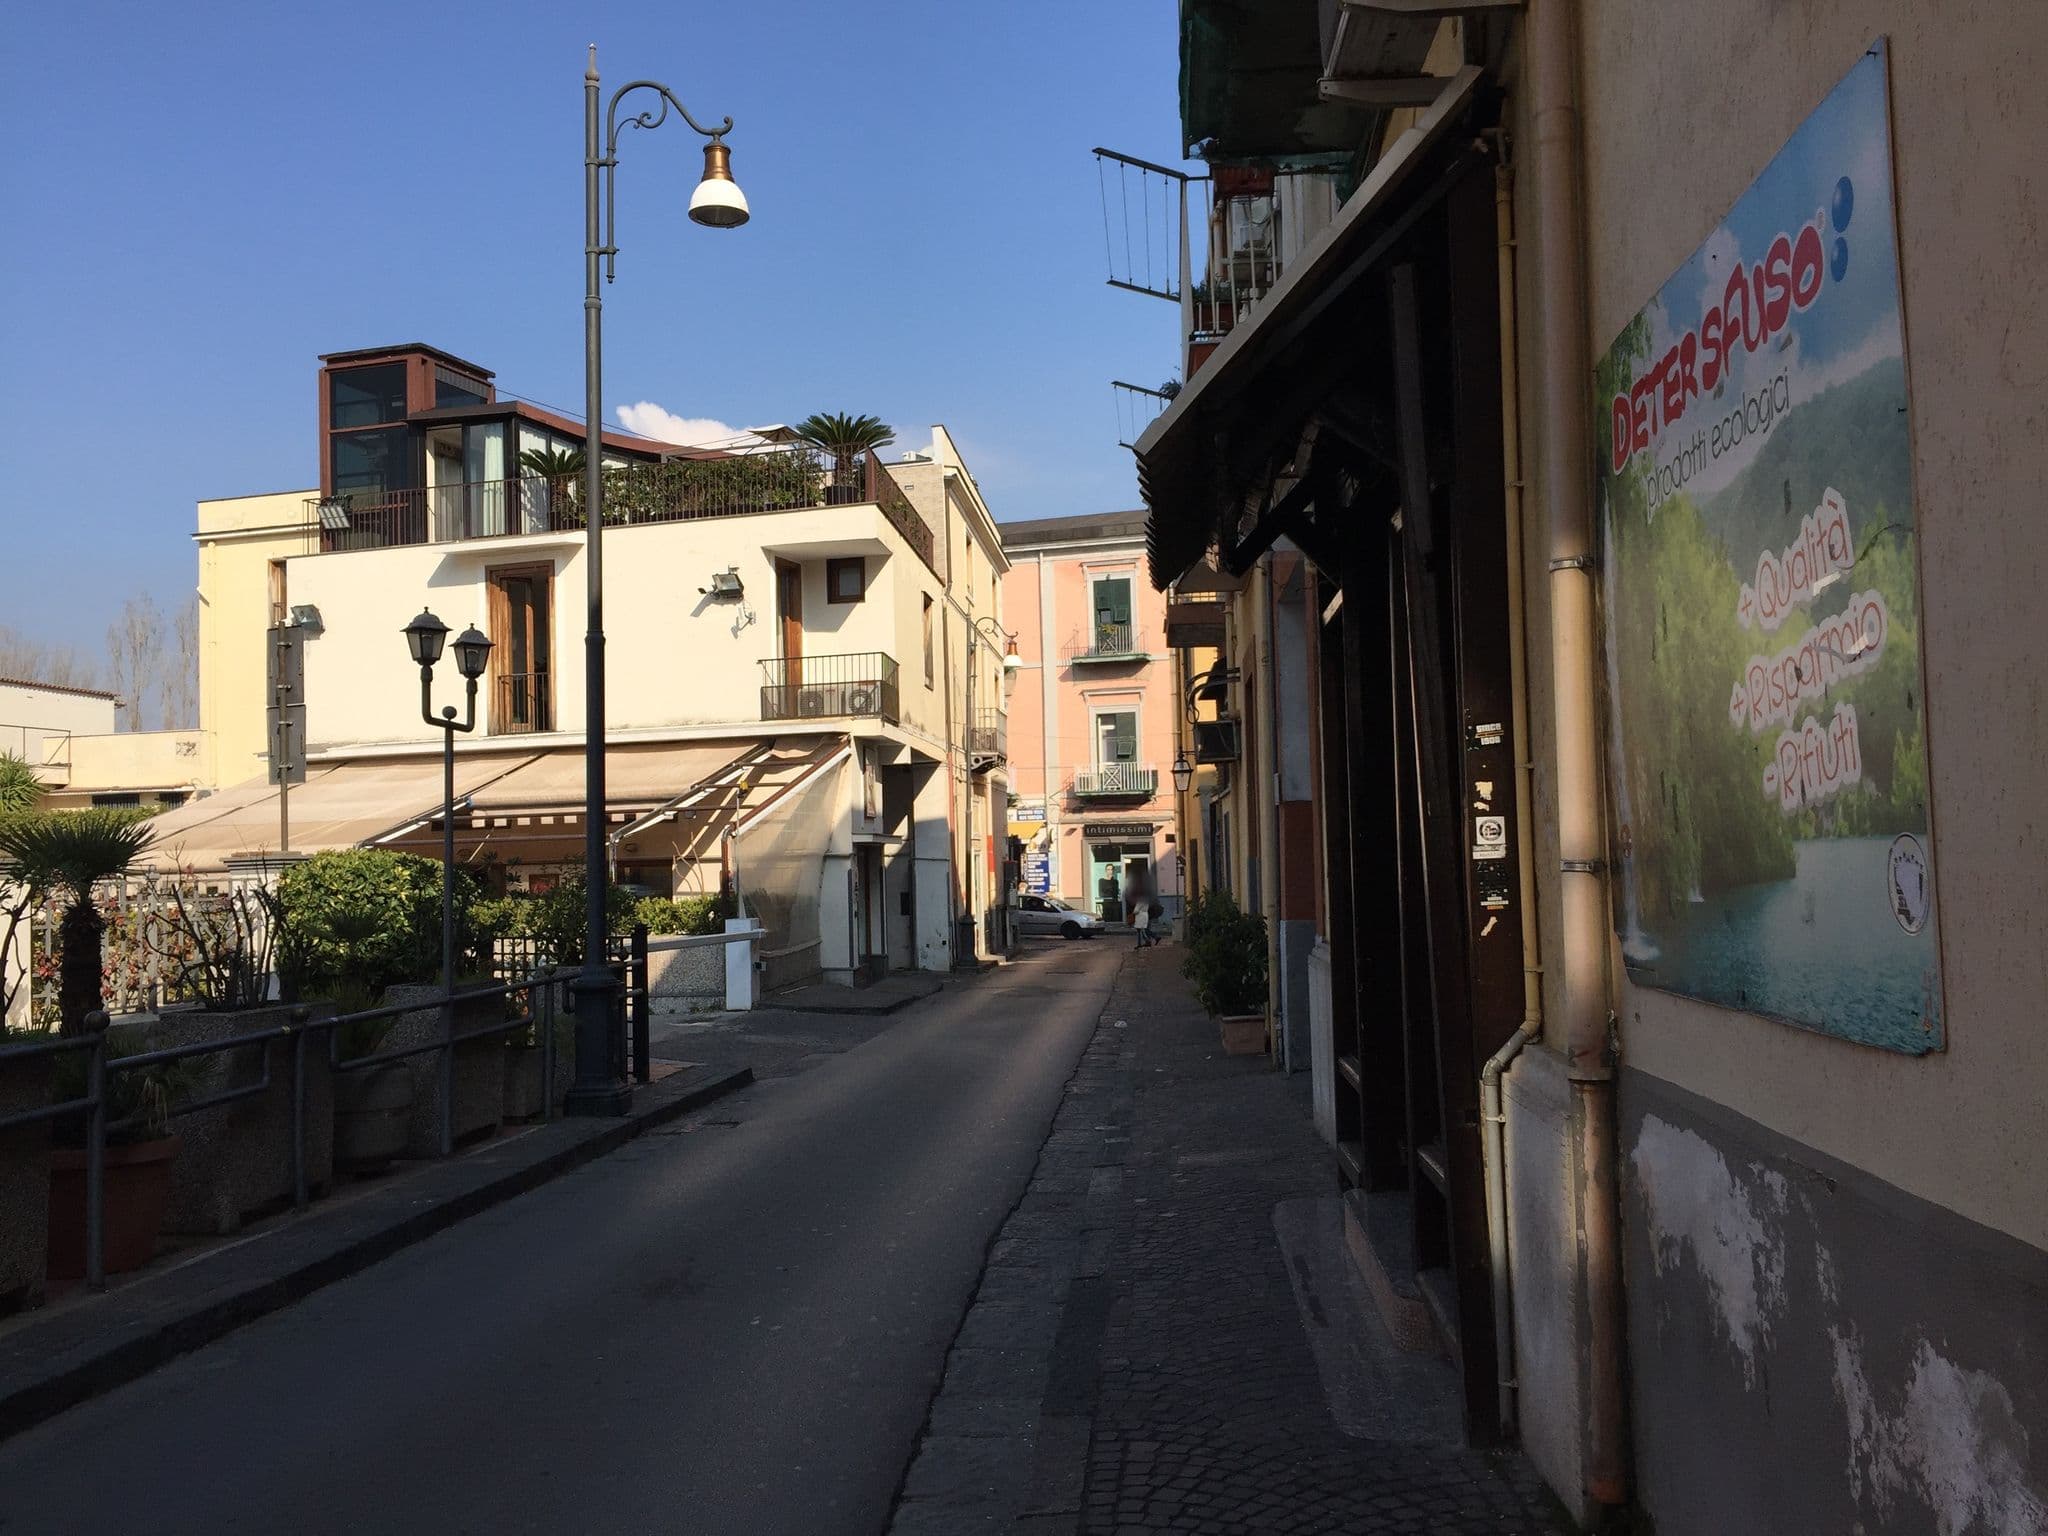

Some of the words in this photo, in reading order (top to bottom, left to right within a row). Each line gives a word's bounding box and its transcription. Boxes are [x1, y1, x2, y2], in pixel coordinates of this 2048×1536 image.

[1613, 226, 1824, 470] DETERSFUSO
[1648, 431, 1707, 514] prodotti
[1712, 367, 1789, 459] ecologici
[1086, 826, 1152, 835] intimissimi
